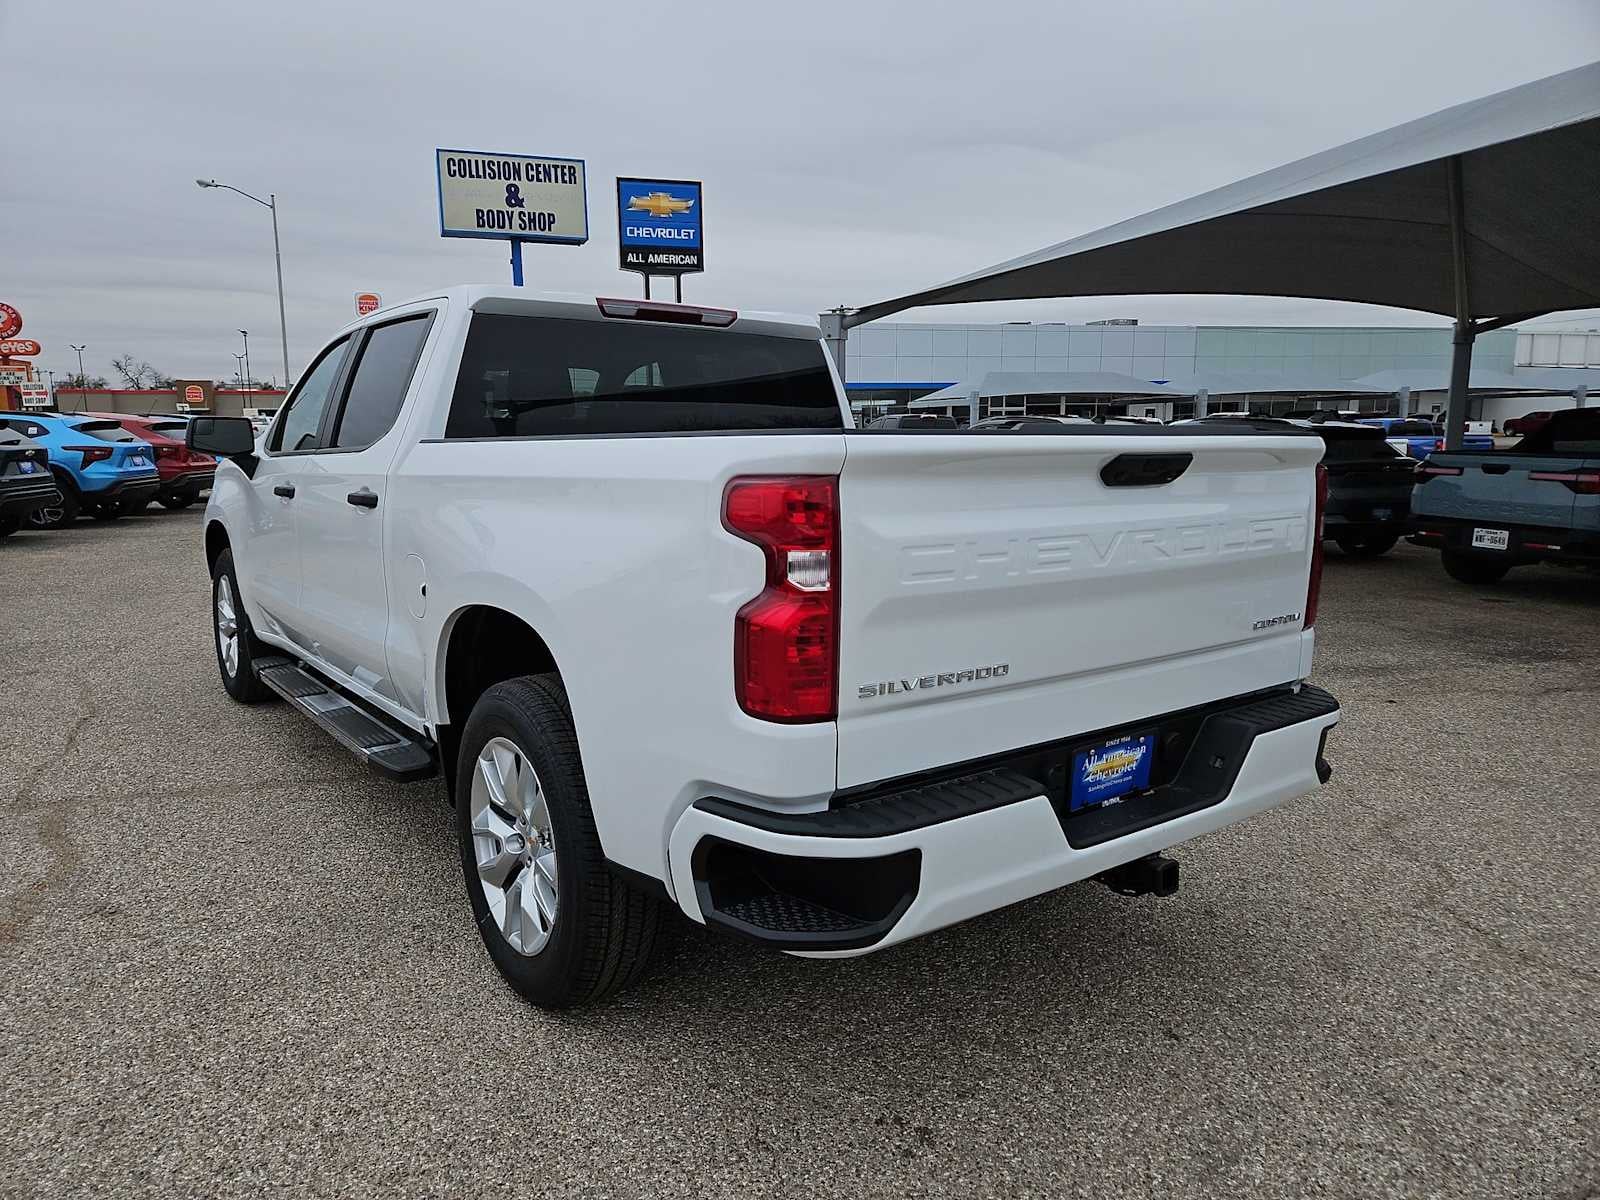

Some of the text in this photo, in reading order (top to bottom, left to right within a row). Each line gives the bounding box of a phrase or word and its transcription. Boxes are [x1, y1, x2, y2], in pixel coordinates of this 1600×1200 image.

[446, 158, 577, 185] COLLISION CENTER
[505, 183, 525, 208] &
[475, 208, 556, 232] BODY SHOP
[626, 226, 696, 241] CHEVROLET
[627, 252, 698, 266] ALL AMERICAN
[901, 515, 1305, 585] CHEVROLET
[1253, 612, 1301, 631] CUSTOM
[858, 663, 1010, 699] SILVERADO
[1082, 745, 1147, 771] All American
[1089, 762, 1137, 783] Chevrolet
